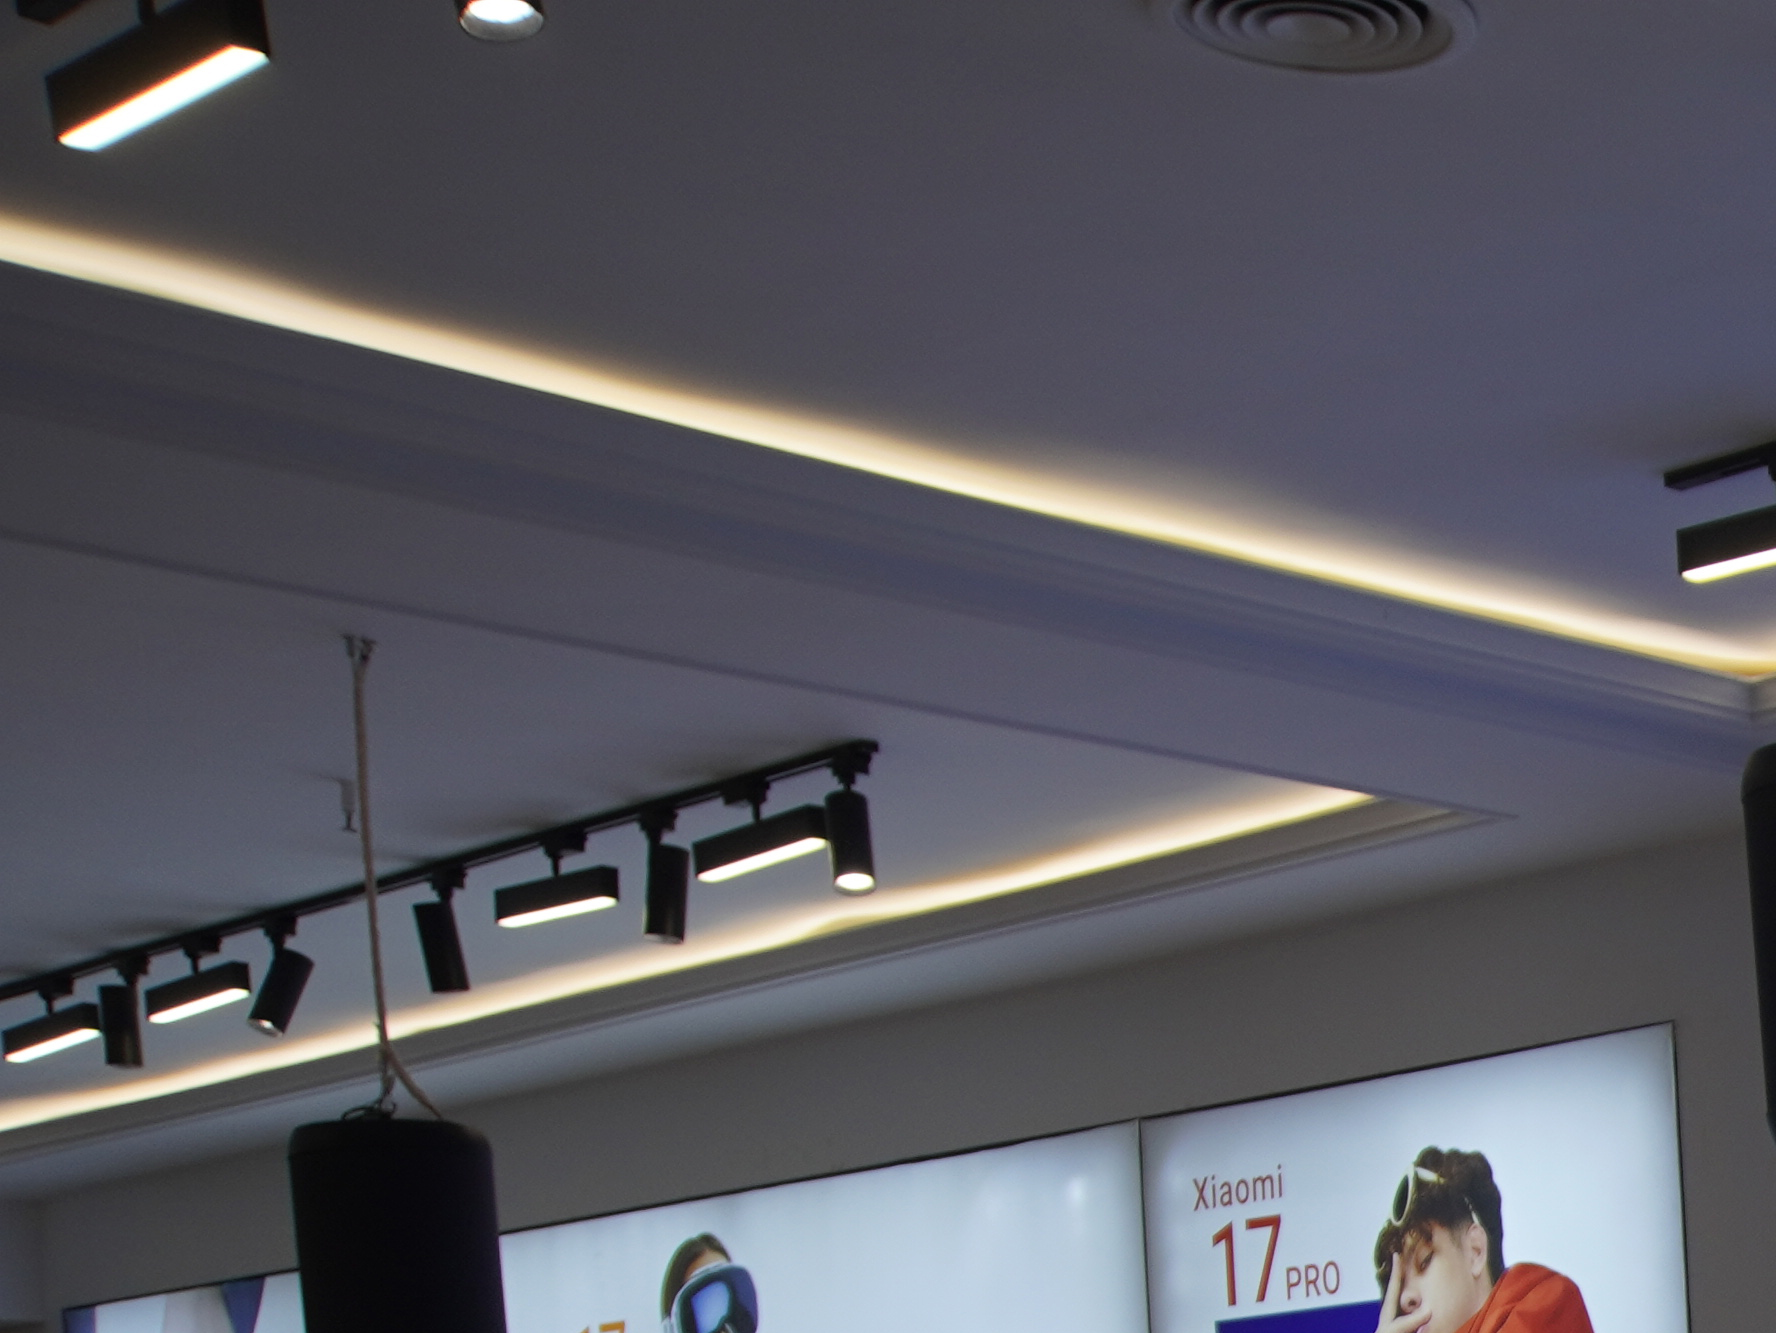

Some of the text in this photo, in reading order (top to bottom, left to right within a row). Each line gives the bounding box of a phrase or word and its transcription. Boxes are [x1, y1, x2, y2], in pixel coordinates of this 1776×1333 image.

[1192, 1165, 1284, 1211] Xiaomi
[1211, 1214, 1341, 1306] 17 PRO
